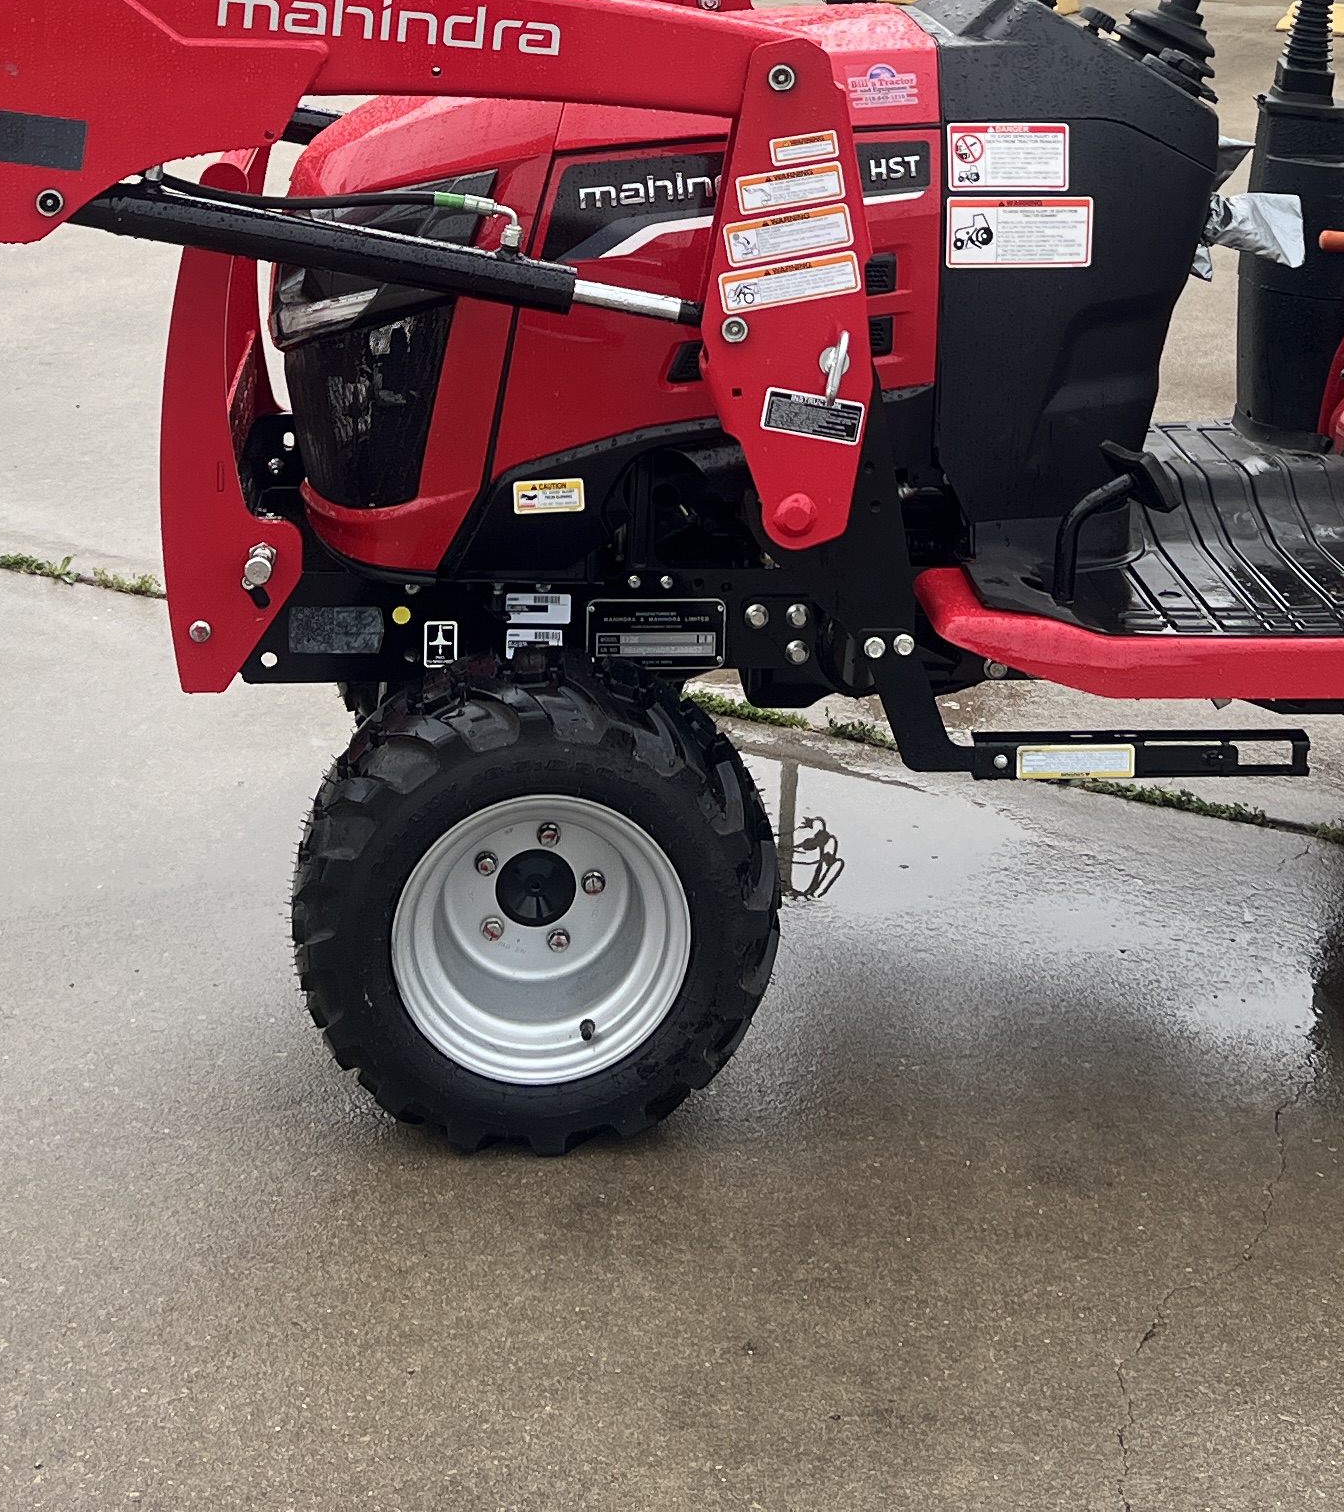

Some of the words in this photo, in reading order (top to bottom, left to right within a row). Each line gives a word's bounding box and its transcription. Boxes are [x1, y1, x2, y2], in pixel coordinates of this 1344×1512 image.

[877, 77, 914, 87] Tractor
[995, 125, 1030, 133] DANGER
[869, 155, 921, 181] HST
[538, 482, 567, 491] CAUTION
